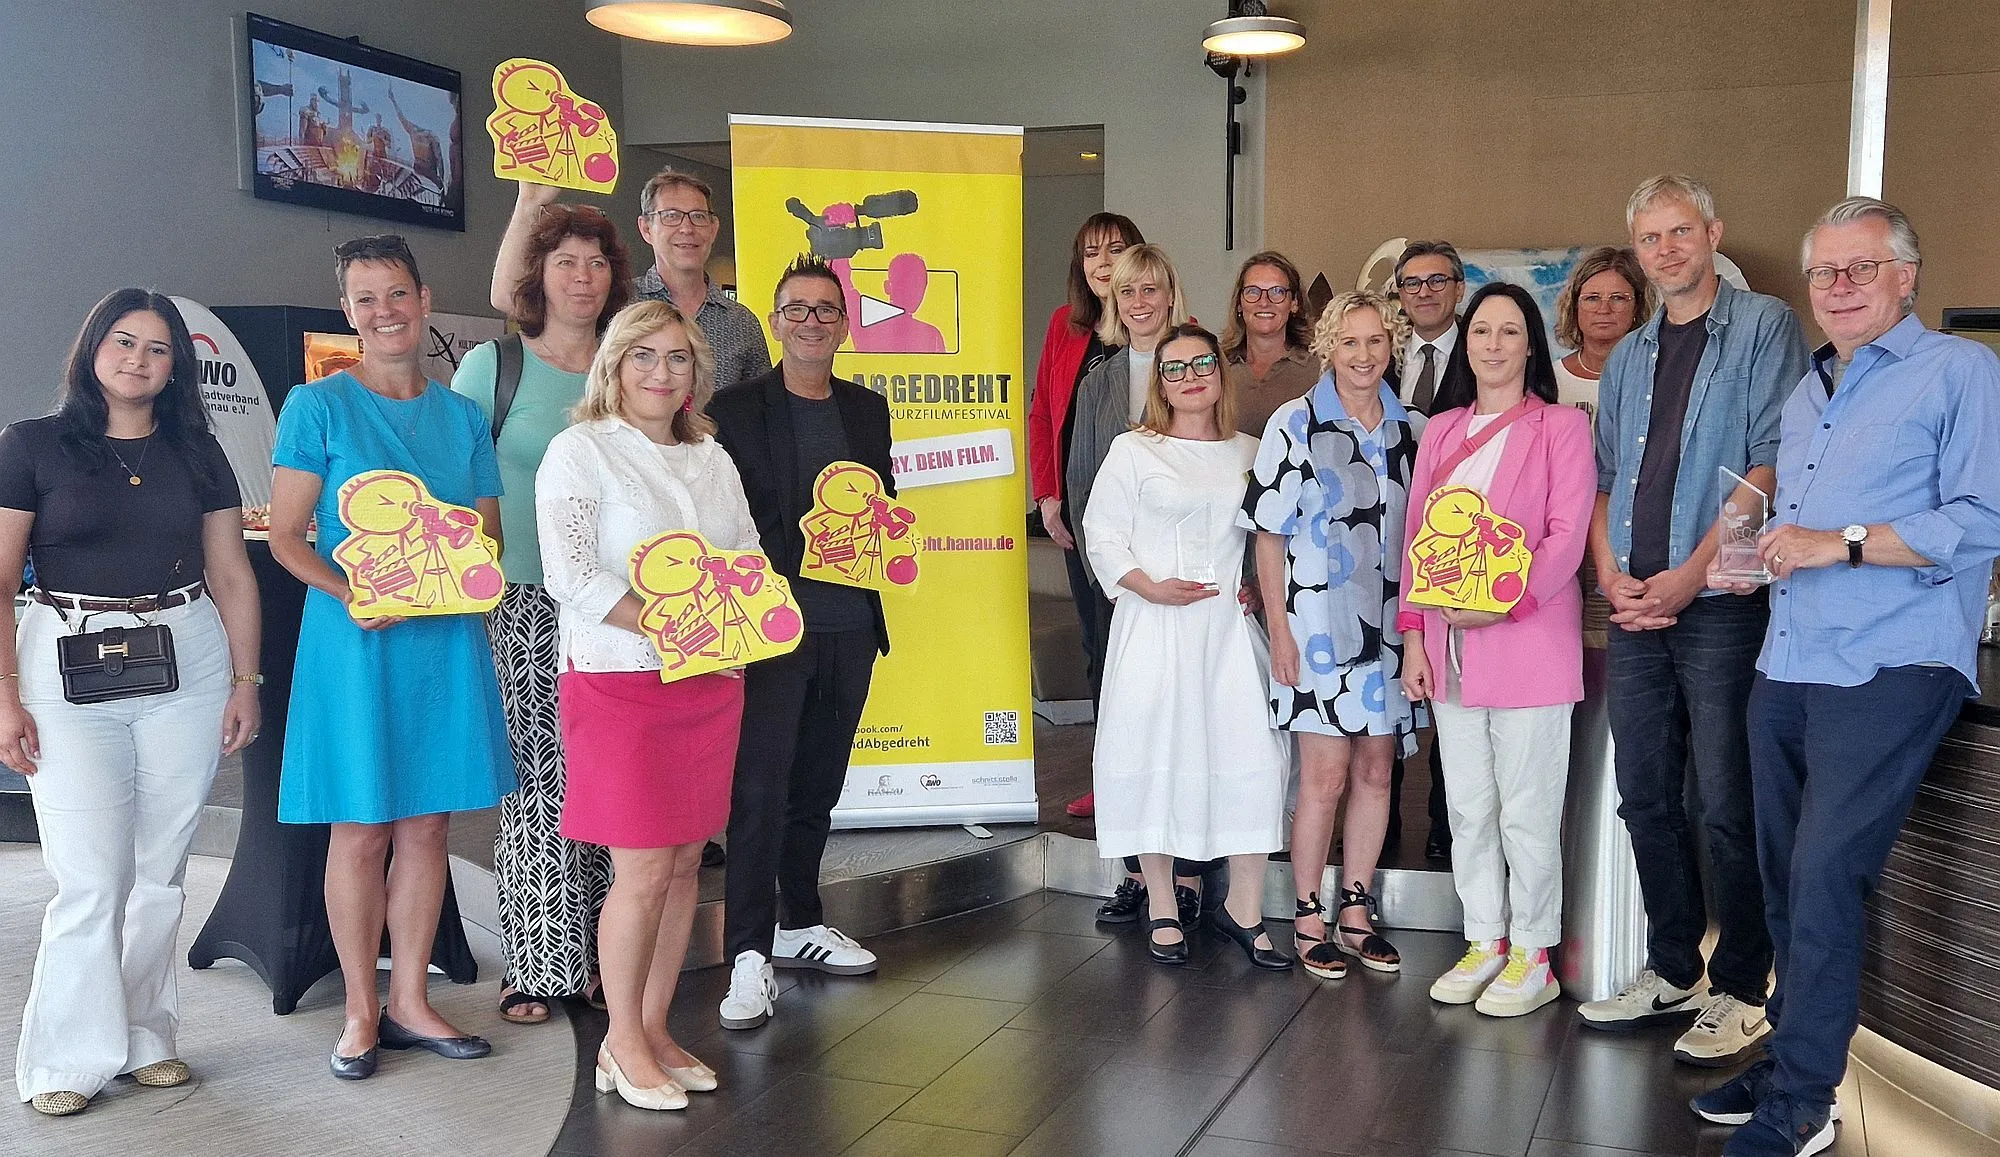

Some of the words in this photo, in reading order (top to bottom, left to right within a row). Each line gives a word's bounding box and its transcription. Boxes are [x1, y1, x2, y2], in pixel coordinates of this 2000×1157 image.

[197, 359, 237, 387] WO
[204, 390, 260, 406] adtverband
[205, 402, 229, 412] anau
[231, 405, 250, 415] e.V.
[892, 455, 913, 474] RY.
[915, 450, 954, 472] DEIN
[956, 444, 1000, 466] FILM.
